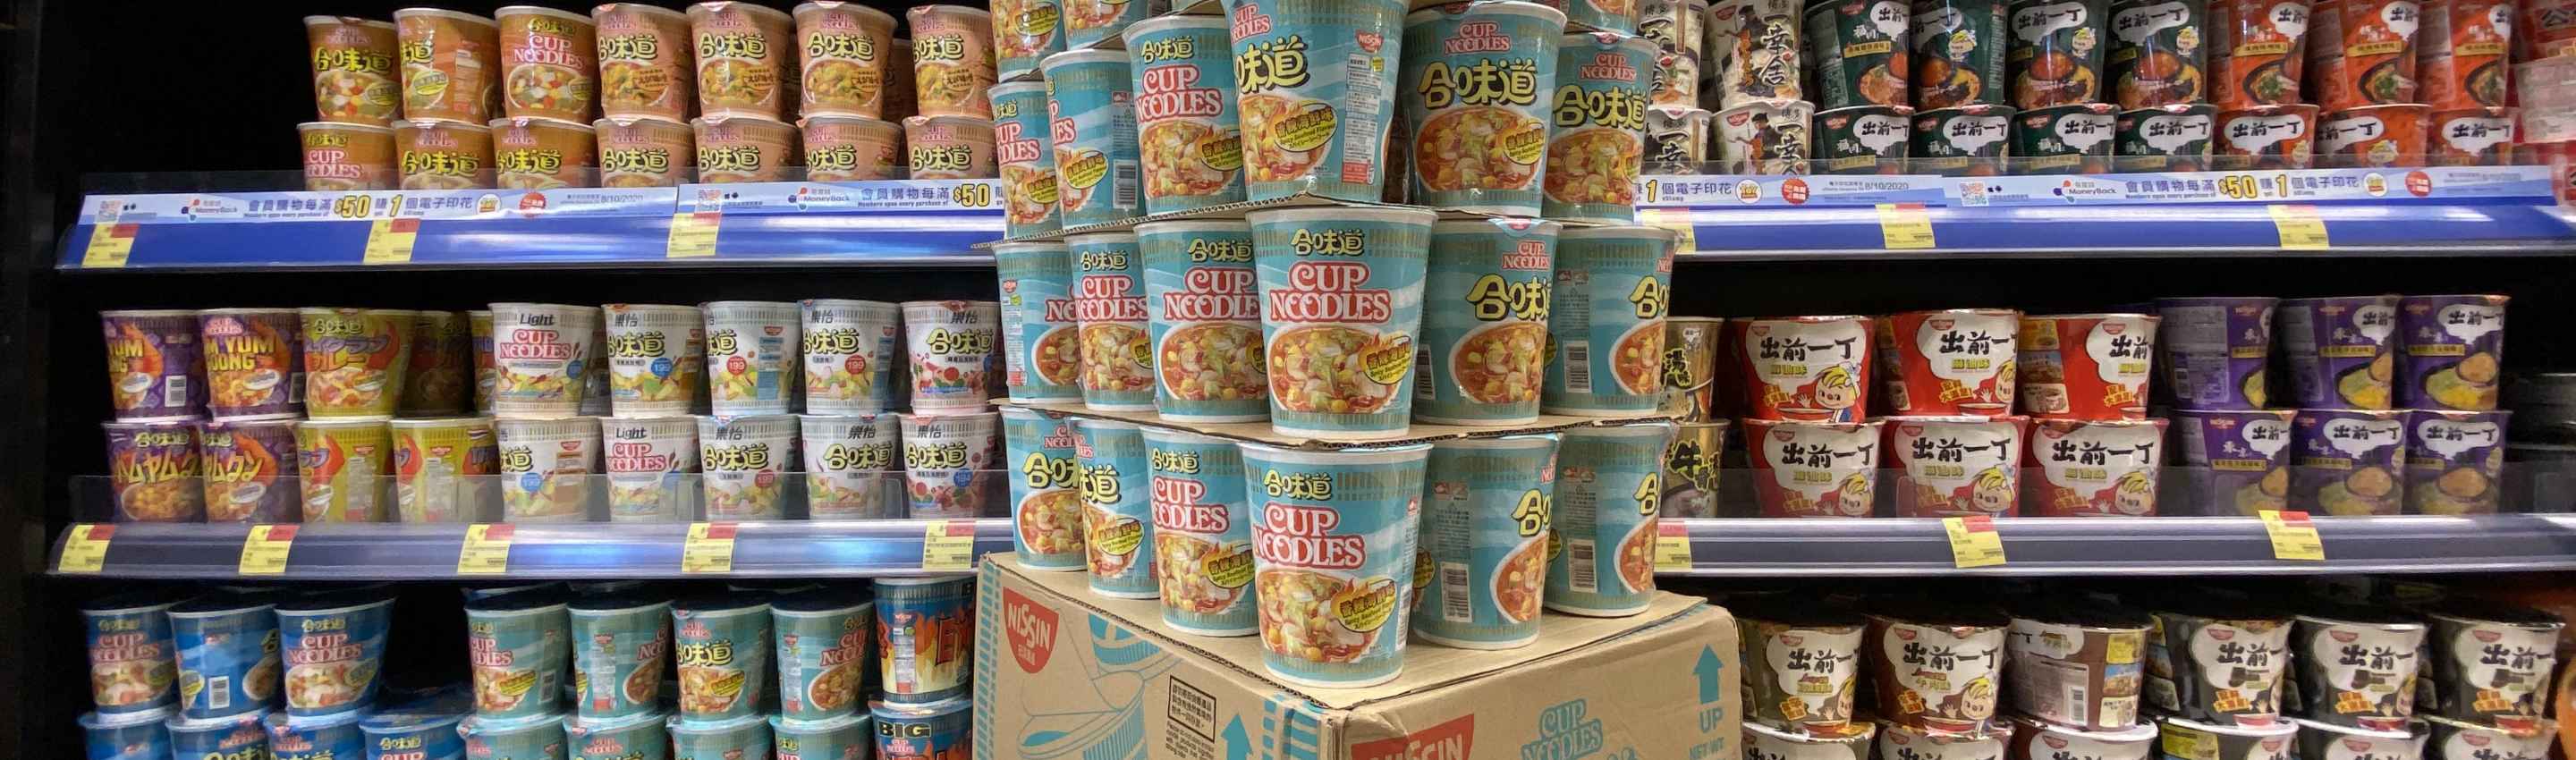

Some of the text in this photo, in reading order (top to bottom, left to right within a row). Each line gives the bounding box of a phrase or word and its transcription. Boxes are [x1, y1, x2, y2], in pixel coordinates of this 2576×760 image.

[1233, 5, 1259, 24] CUP
[2016, 8, 2083, 30] 出前一丁
[2118, 8, 2185, 31] 出前一丁
[1458, 21, 1496, 38] CUP
[529, 35, 572, 51] CUP
[597, 34, 657, 62] 合味道
[698, 32, 767, 60] 合味道
[807, 31, 874, 61] 合味道
[912, 34, 964, 63] 合味道
[1140, 36, 1195, 63] 合味道
[1444, 35, 1512, 54] NOODLES
[314, 46, 393, 72] 合味道
[513, 48, 586, 71] NOODLES
[1235, 35, 1309, 94] 味道
[1593, 54, 1626, 68] CUP
[1141, 65, 1200, 92] CUP
[1417, 58, 1538, 109] 合味道
[1580, 66, 1640, 82] NOODLES
[1136, 89, 1224, 122] NOODLES
[1553, 85, 1648, 130] 合味道
[1952, 120, 2007, 138] 出前一丁
[2063, 119, 2114, 136] 出前一丁
[2148, 121, 2208, 137] 出前一丁
[2232, 121, 2301, 139] 出前一丁
[308, 149, 346, 164] CUP
[402, 150, 480, 176] 合味道
[496, 148, 562, 174] 合味道
[601, 146, 669, 174] 合味道
[698, 146, 760, 173] 合味道
[910, 145, 972, 171] 合味道
[953, 183, 990, 207] $50
[1644, 179, 1733, 203] 1 個電子印花
[1864, 182, 1909, 190] 8/10/2020
[2218, 175, 2258, 198] $50
[2275, 174, 2288, 198] 1
[334, 195, 371, 218] $50
[390, 194, 402, 217] 1
[1187, 238, 1252, 262] 合味道
[1290, 228, 1365, 257] 合味道
[1516, 241, 1545, 257] CUP
[1080, 251, 1129, 272] 合味道
[1502, 255, 1551, 270] NOODLES
[1080, 276, 1133, 299] CUP
[1184, 267, 1257, 295] CUP
[1289, 263, 1368, 293] CUP
[1076, 298, 1149, 322] NOODLES
[1163, 294, 1261, 321] NOODLE
[1269, 290, 1392, 322] NOODLES
[520, 314, 555, 325] Light
[225, 335, 275, 354] YUM
[513, 330, 560, 344] CUP
[608, 331, 665, 357] 合味道
[804, 328, 860, 355] 合味道
[926, 328, 994, 355] 合味道
[1760, 336, 1857, 362] 出前一丁
[1938, 329, 2017, 355] 出前一丁
[500, 342, 573, 359] NOODLES
[616, 427, 648, 439] Light
[849, 425, 877, 439] 樂怡
[917, 425, 943, 439] 樂怡
[2333, 424, 2400, 441] 出前一丁
[2426, 426, 2496, 443] 出前一丁
[613, 443, 652, 458] CUP
[703, 443, 770, 470] 合味道
[825, 442, 894, 470] 合味道
[906, 443, 968, 469] 合味道
[1151, 448, 1201, 475] 合味道
[1782, 443, 1874, 469] 出前一丁
[1911, 436, 2012, 463] 出前一丁
[2051, 439, 2154, 466] 出前一丁
[1153, 475, 1206, 507] CUP
[1263, 469, 1334, 501] 合味道
[1264, 502, 1340, 536] CUP
[1252, 526, 1367, 570] NOODLES
[1007, 602, 1052, 652] NISSIN
[99, 633, 146, 648] CUP
[301, 633, 350, 650] CUP
[676, 638, 734, 666] 合味道
[285, 645, 362, 664] NOODLES
[1902, 641, 1999, 671] 出前一丁
[878, 722, 932, 739] BIG
[1542, 697, 1587, 739] CUP
[1699, 707, 1724, 734] UP
